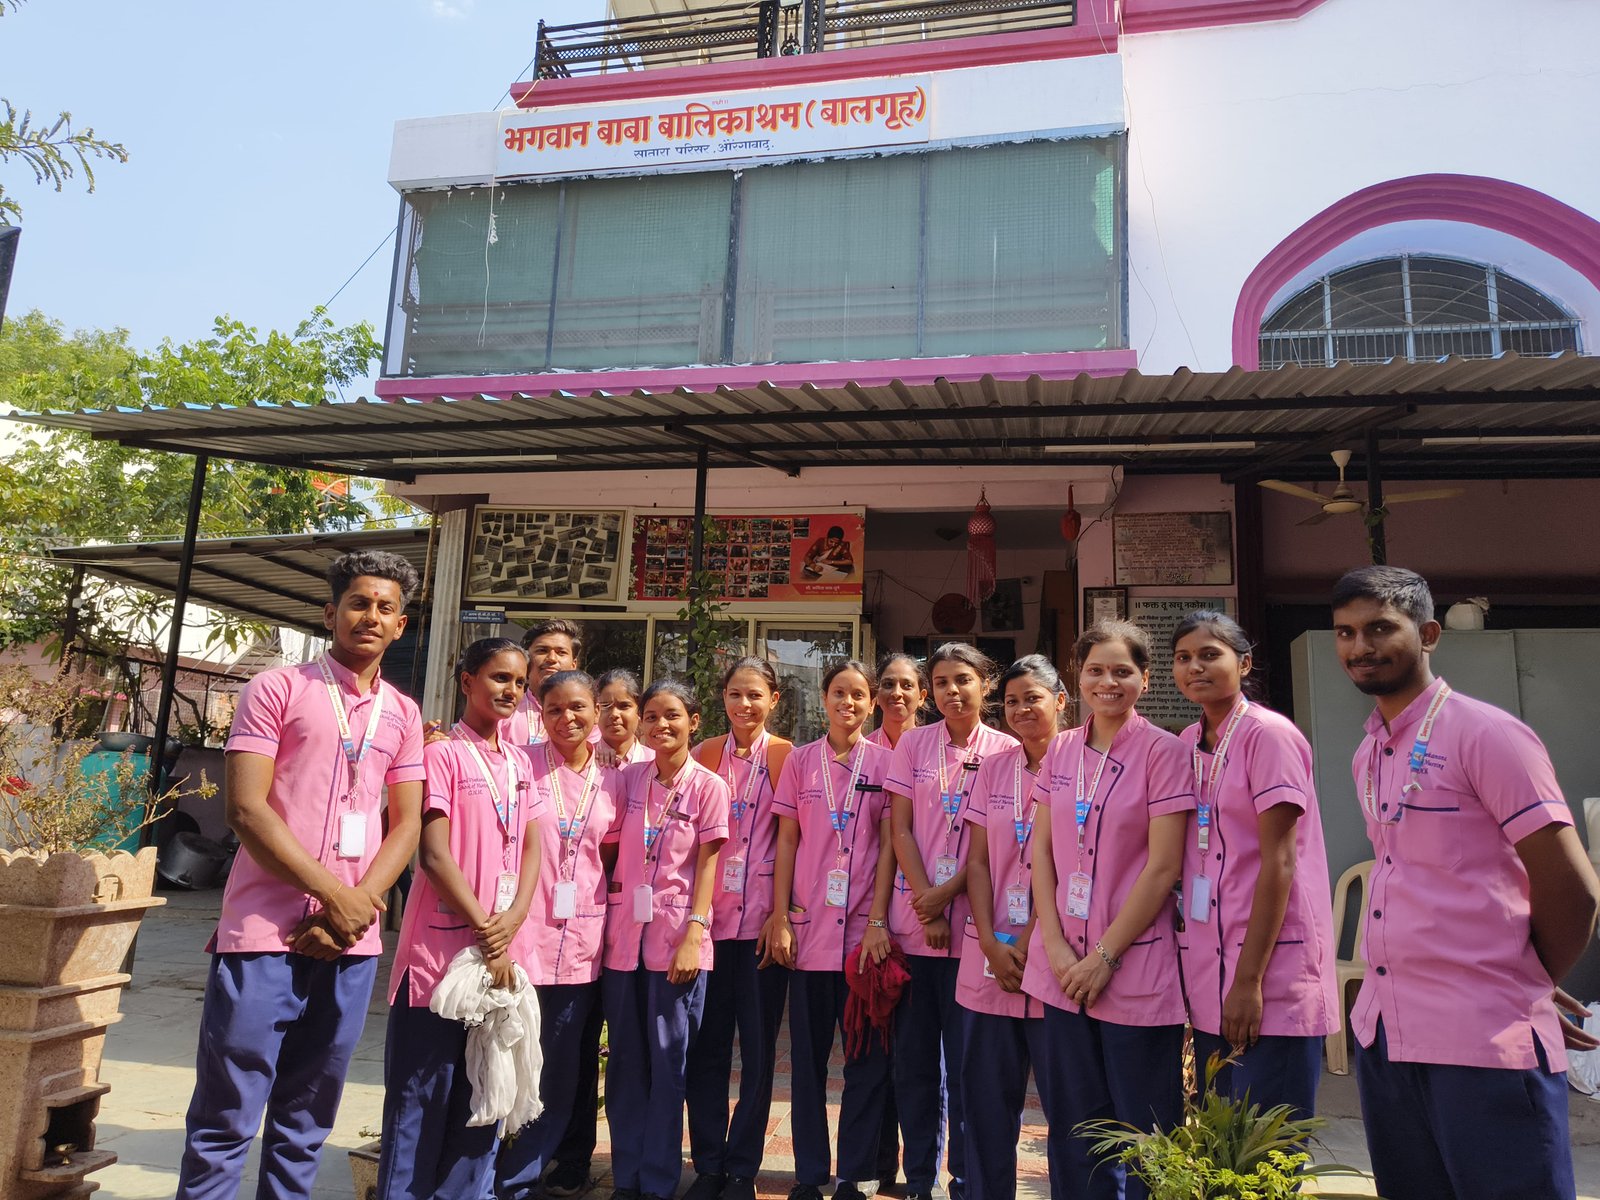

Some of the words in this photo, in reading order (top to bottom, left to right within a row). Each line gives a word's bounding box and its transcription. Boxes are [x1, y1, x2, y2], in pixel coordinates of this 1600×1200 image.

[504, 121, 593, 154] भगवान
[597, 115, 653, 146] बाबा
[658, 102, 803, 141] बालिकाश्रम
[805, 85, 927, 131] (बालगृह)
[633, 147, 670, 158] सातारा
